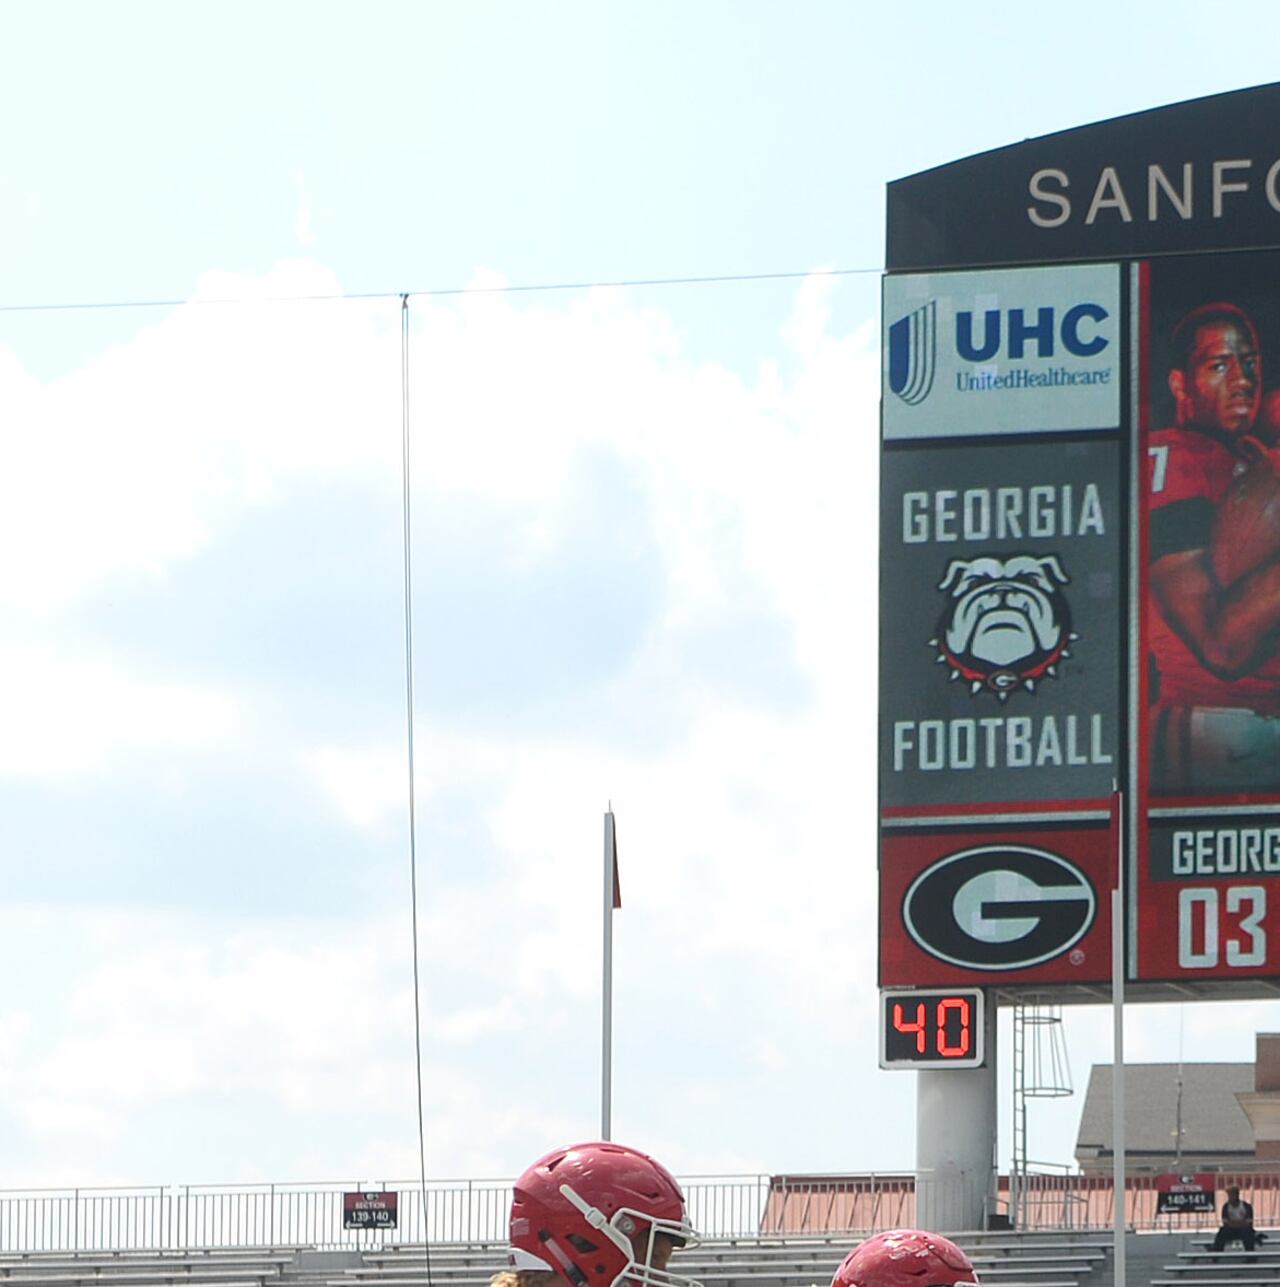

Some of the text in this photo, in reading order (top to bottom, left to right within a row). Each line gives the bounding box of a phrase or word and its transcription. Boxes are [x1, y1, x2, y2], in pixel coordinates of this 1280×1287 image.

[955, 302, 1109, 363] UHC
[956, 367, 1111, 392] UnitedHealthcare
[902, 483, 1106, 544] GEORGIA
[893, 714, 1112, 772] FOOTBALL
[1177, 886, 1266, 970] 03
[892, 998, 970, 1057] 40
[352, 1211, 389, 1221] 139-140
